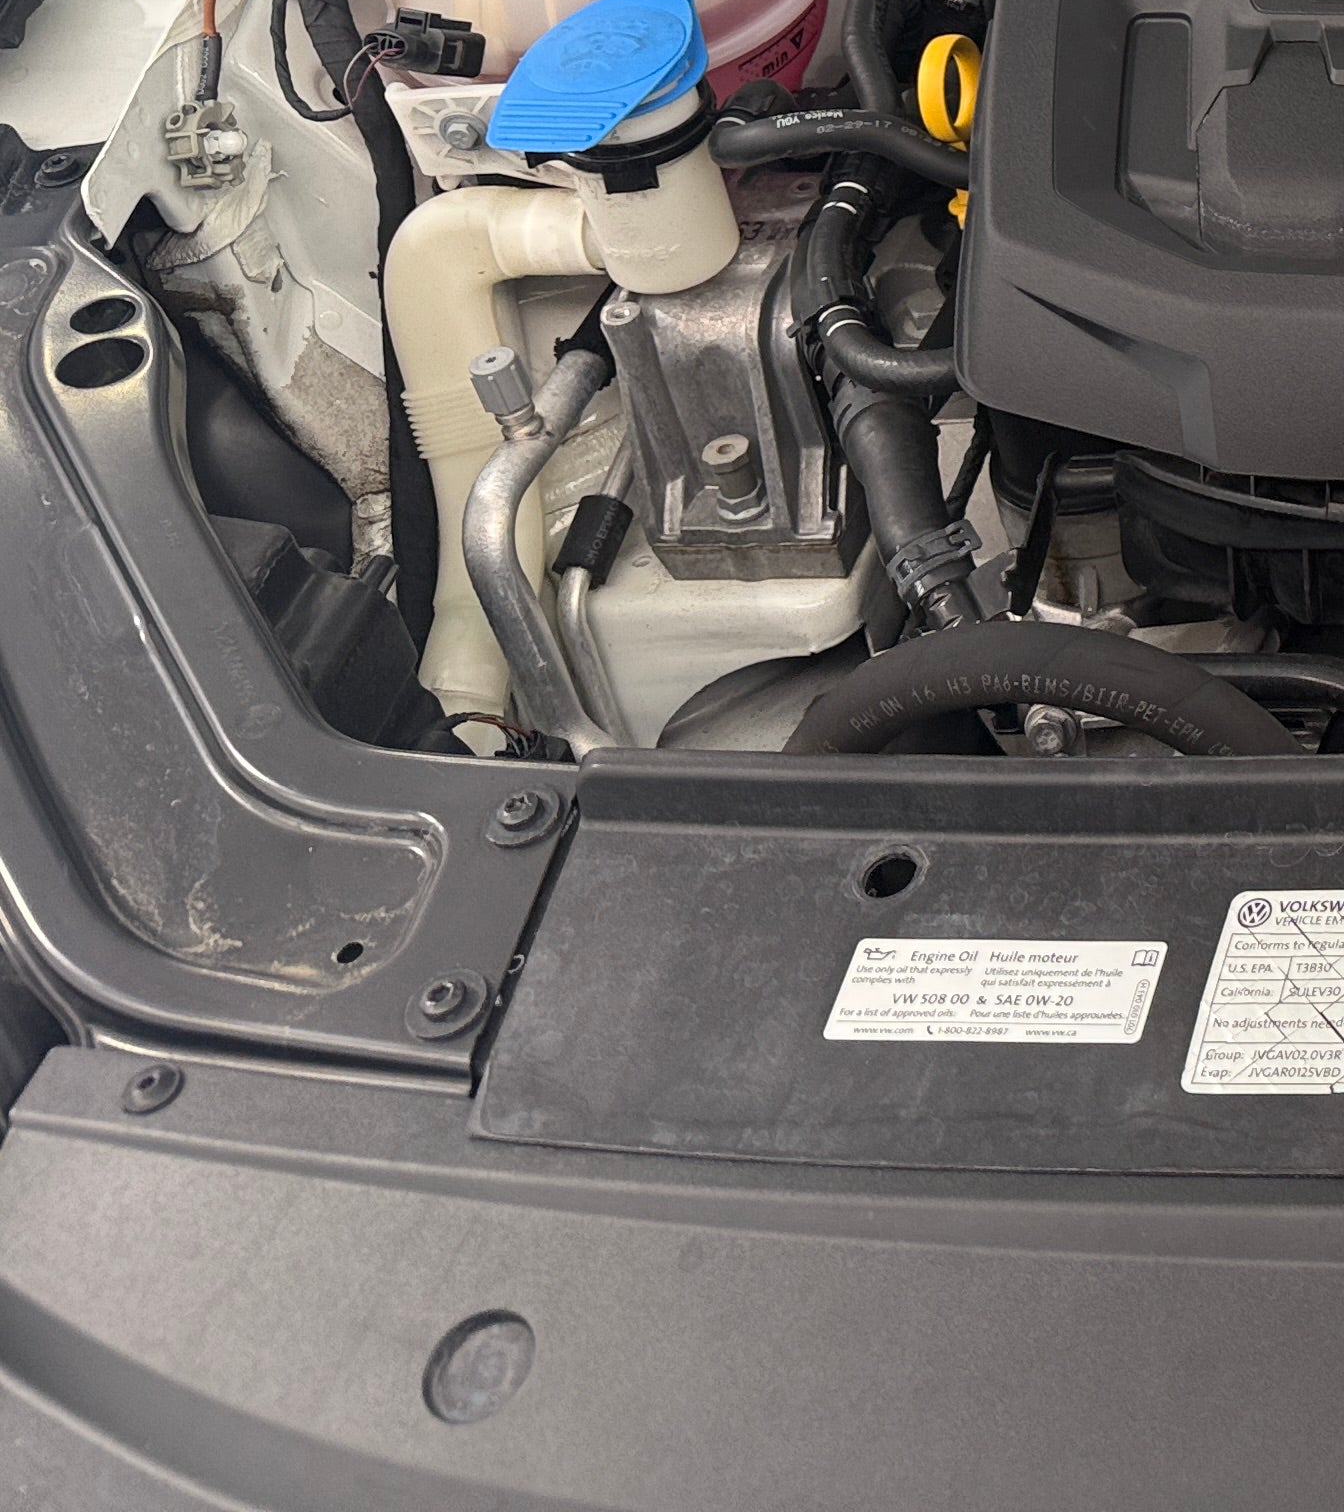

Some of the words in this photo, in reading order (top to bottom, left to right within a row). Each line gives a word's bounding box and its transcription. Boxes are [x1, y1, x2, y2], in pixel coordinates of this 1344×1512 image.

[1275, 915, 1322, 927] VEHICLE
[910, 950, 956, 964] Engine
[958, 950, 979, 962] Oil
[989, 951, 1026, 963] Huile
[1027, 952, 1080, 963] moteur
[892, 993, 919, 1005] VW
[920, 993, 948, 1005] 508
[950, 993, 970, 1005] 00
[976, 995, 988, 1005] &
[994, 994, 1022, 1006] SAE
[1025, 994, 1074, 1007] 0W-20
[1212, 1018, 1230, 1028] No
[1231, 1016, 1308, 1032] adjustments
